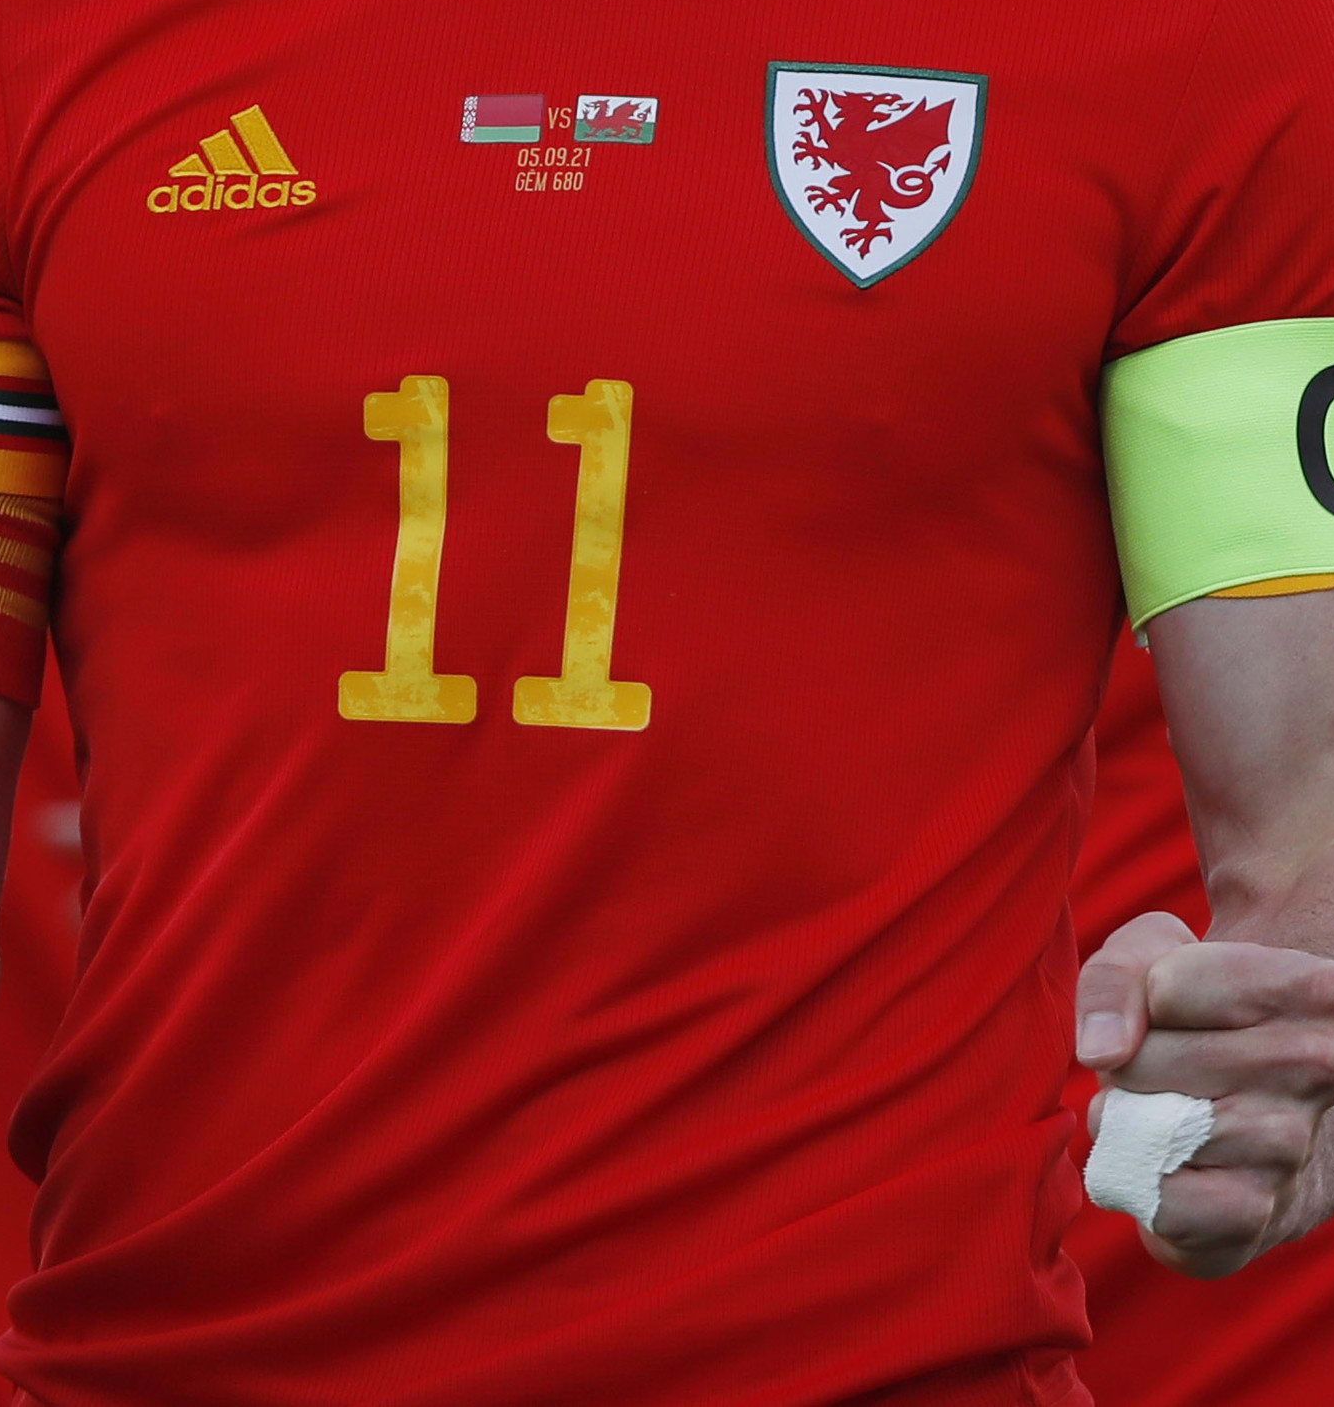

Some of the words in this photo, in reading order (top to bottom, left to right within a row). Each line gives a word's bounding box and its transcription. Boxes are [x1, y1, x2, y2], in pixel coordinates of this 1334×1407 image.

[547, 107, 572, 130] VS
[517, 147, 592, 168] 05.09.21
[552, 170, 584, 191] 680
[146, 173, 317, 213] adidas
[337, 374, 652, 731] 11
